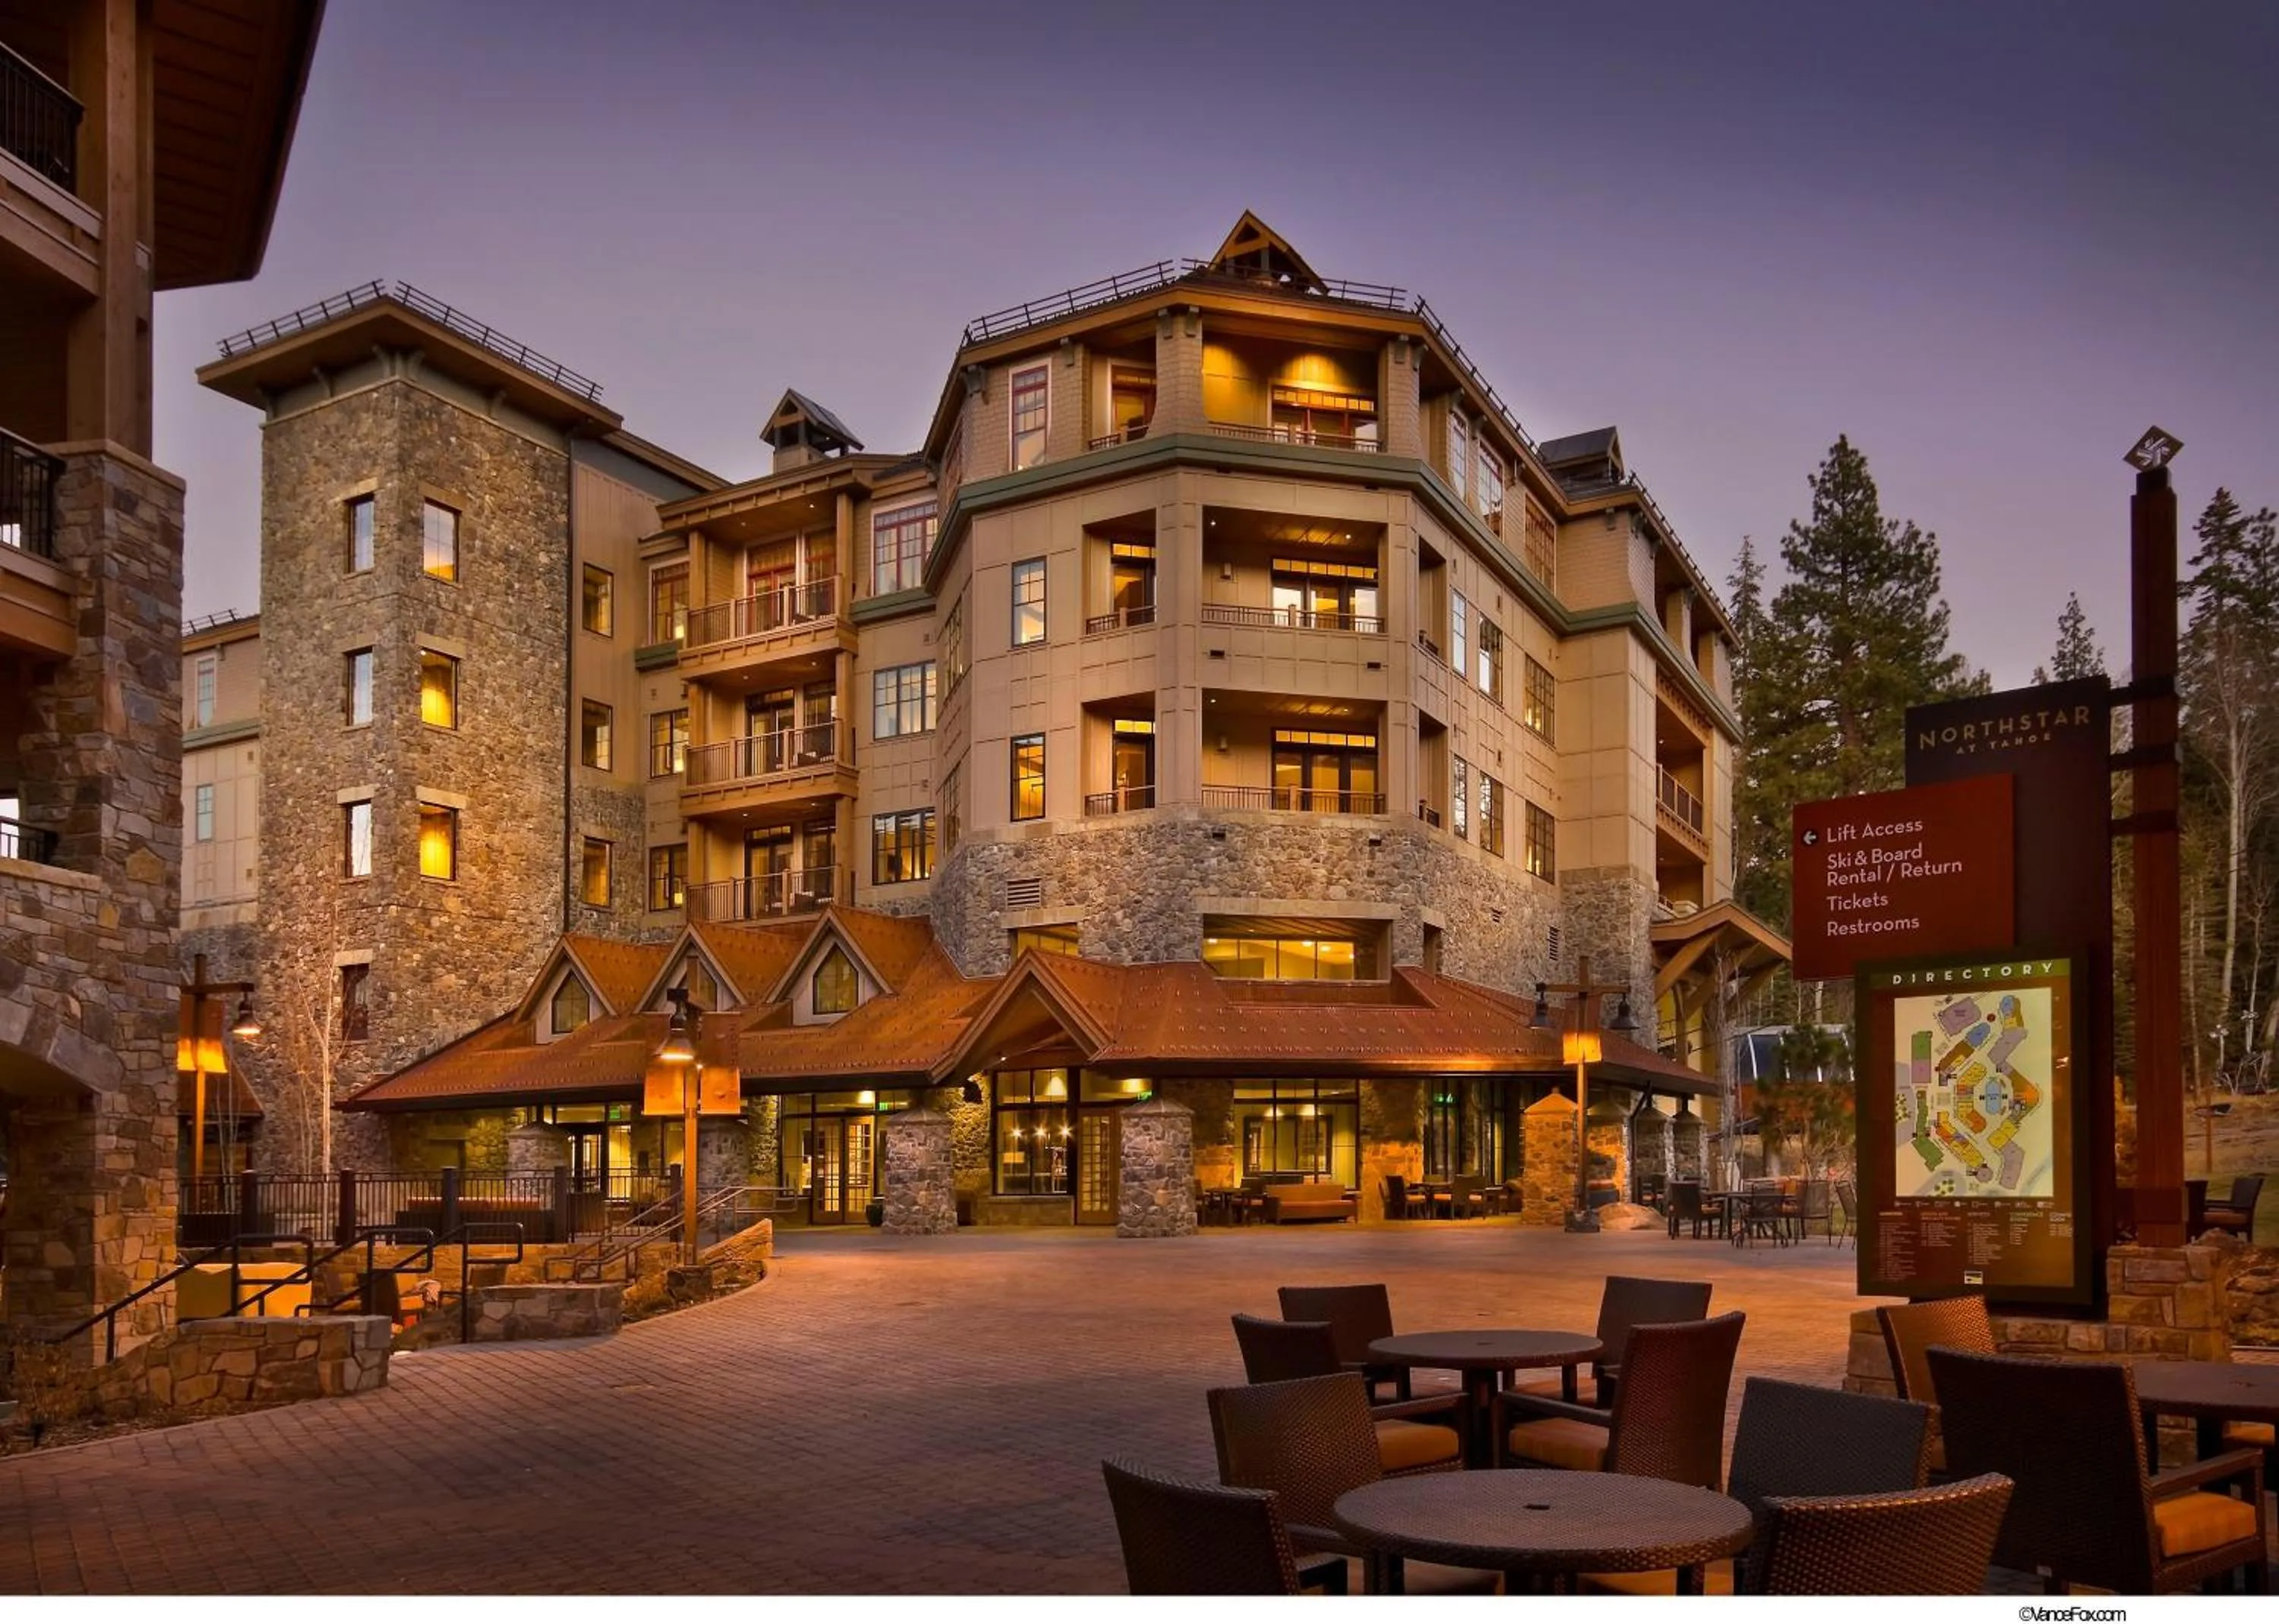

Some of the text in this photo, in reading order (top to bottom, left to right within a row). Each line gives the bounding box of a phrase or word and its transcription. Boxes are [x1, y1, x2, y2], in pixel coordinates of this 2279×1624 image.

[1919, 706, 2090, 750] NORTHSTAR
[1956, 733, 2051, 754] AT TAHOE
[1827, 820, 1923, 842] Lift Access
[1827, 841, 1923, 870] Ski & Board
[1827, 860, 1963, 886] Rental / Return
[1826, 892, 1889, 911] Tickets
[1827, 917, 1920, 936] Restrooms
[1892, 962, 2053, 985] DIRECTORY
